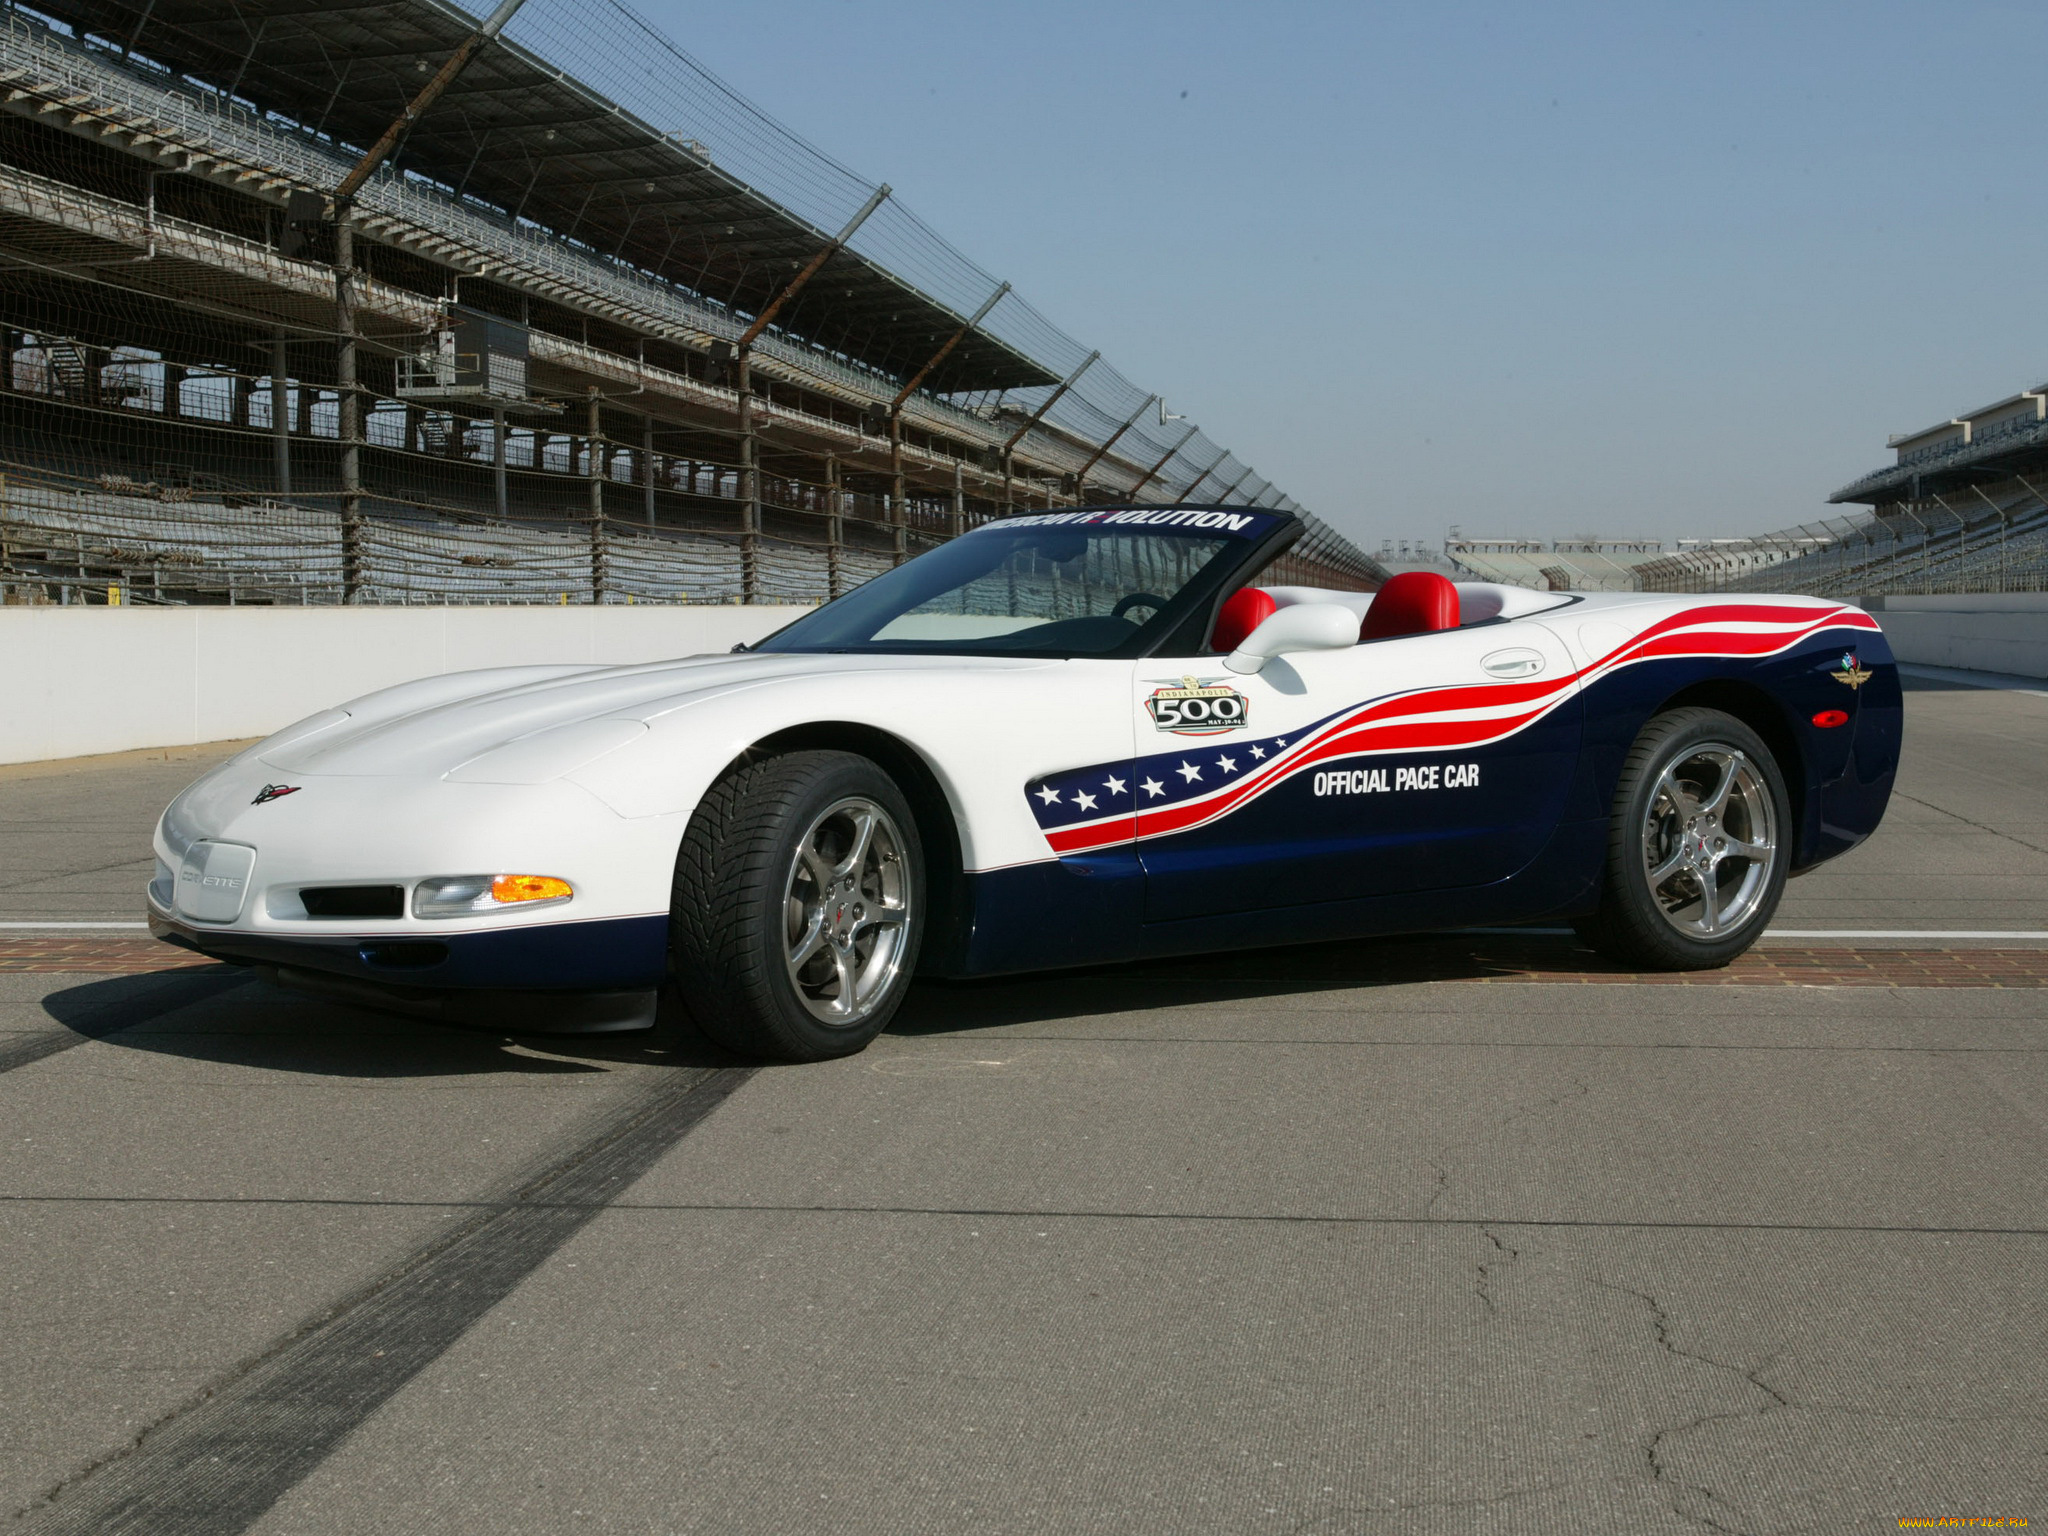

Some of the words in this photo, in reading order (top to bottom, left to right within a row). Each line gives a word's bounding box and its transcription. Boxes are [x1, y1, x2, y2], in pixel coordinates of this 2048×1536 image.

[973, 512, 1086, 532] MERICAN
[1161, 689, 1229, 698] INDIANAPOLIS
[1157, 698, 1242, 727] 500
[1314, 769, 1390, 796] OFFICIAL
[1395, 766, 1439, 791] PACE
[1444, 764, 1480, 788] CAR
